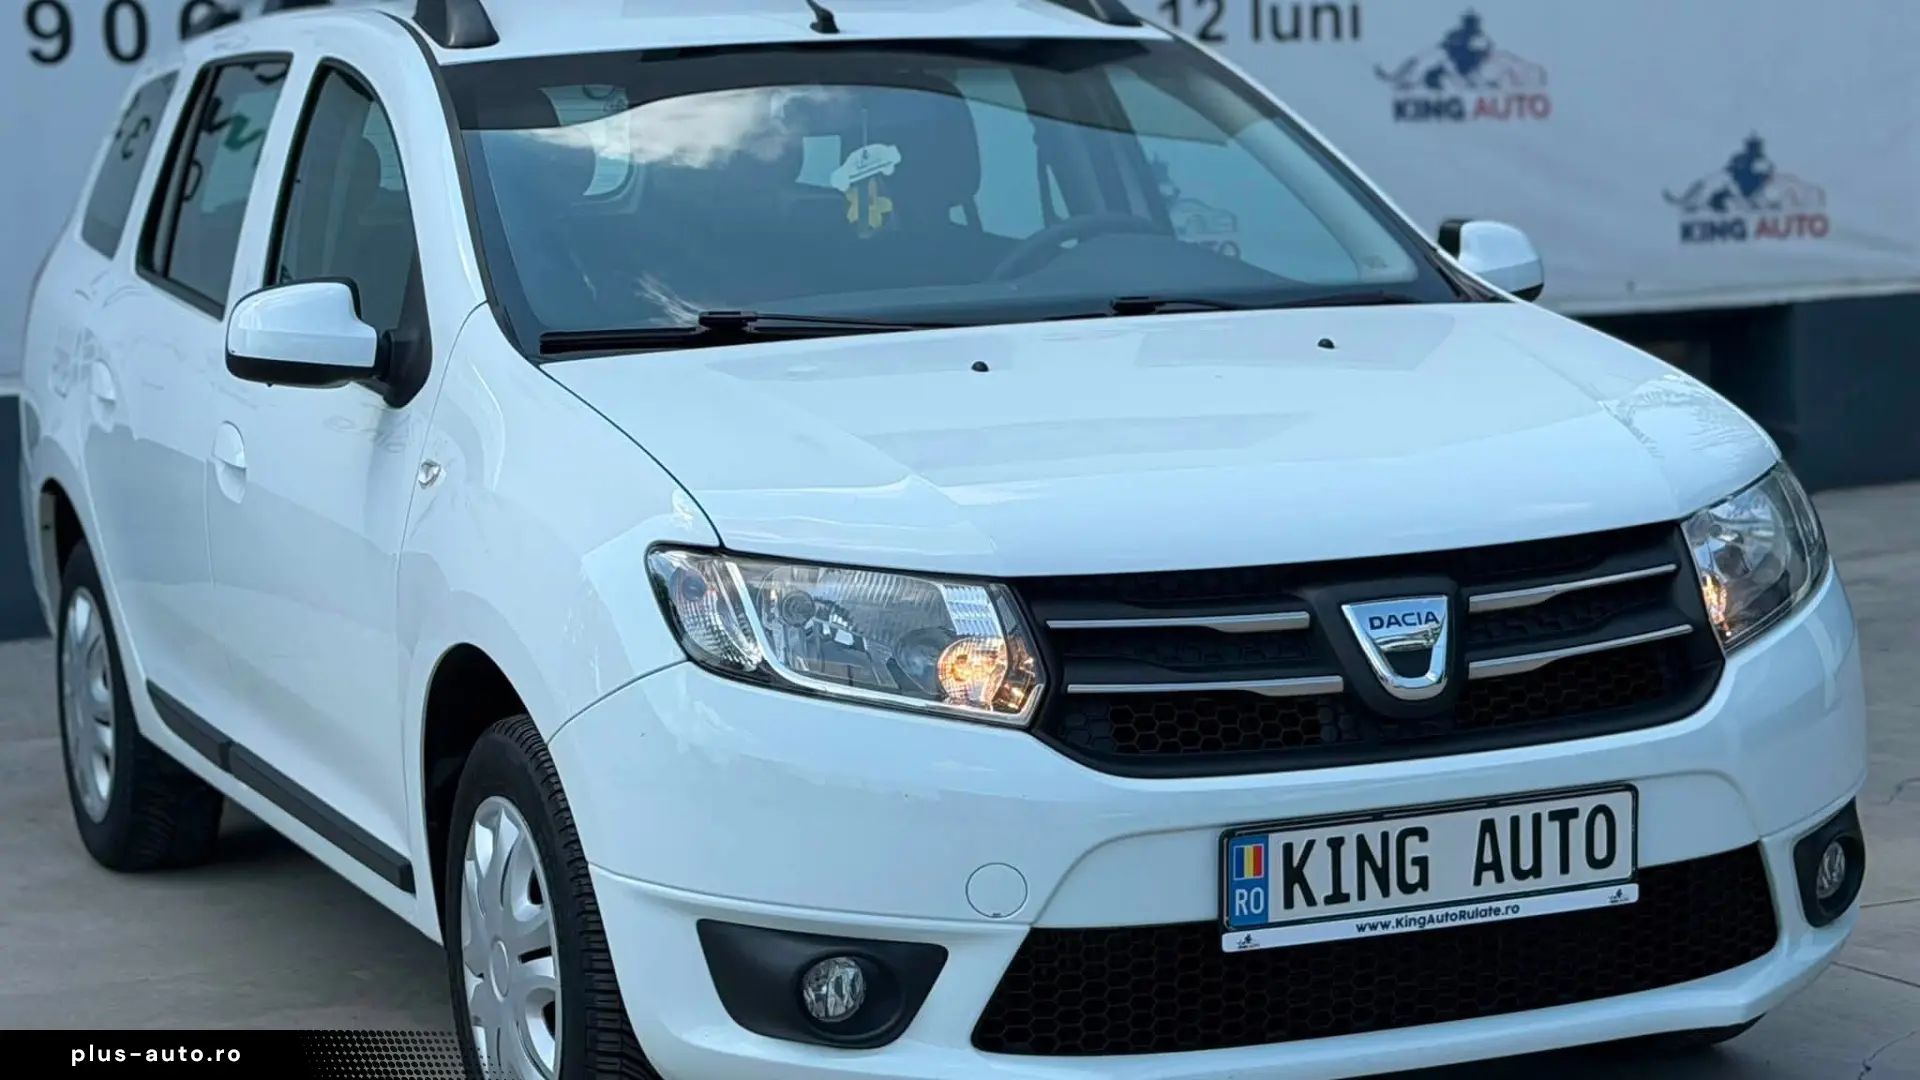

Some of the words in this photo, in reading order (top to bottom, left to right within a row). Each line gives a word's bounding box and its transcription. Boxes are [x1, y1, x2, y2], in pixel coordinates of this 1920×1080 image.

[1252, 0, 1361, 42] luni
[1393, 97, 1466, 122] KING
[1474, 93, 1552, 120] AUTO
[1680, 218, 1746, 242] KING
[1755, 213, 1829, 239] AUTO
[1368, 611, 1440, 631] DACIA
[1282, 826, 1430, 911] KING
[1472, 803, 1618, 888] AUTO
[1235, 887, 1265, 916] RO
[1356, 903, 1521, 933] www.KingAutoRulate.ro
